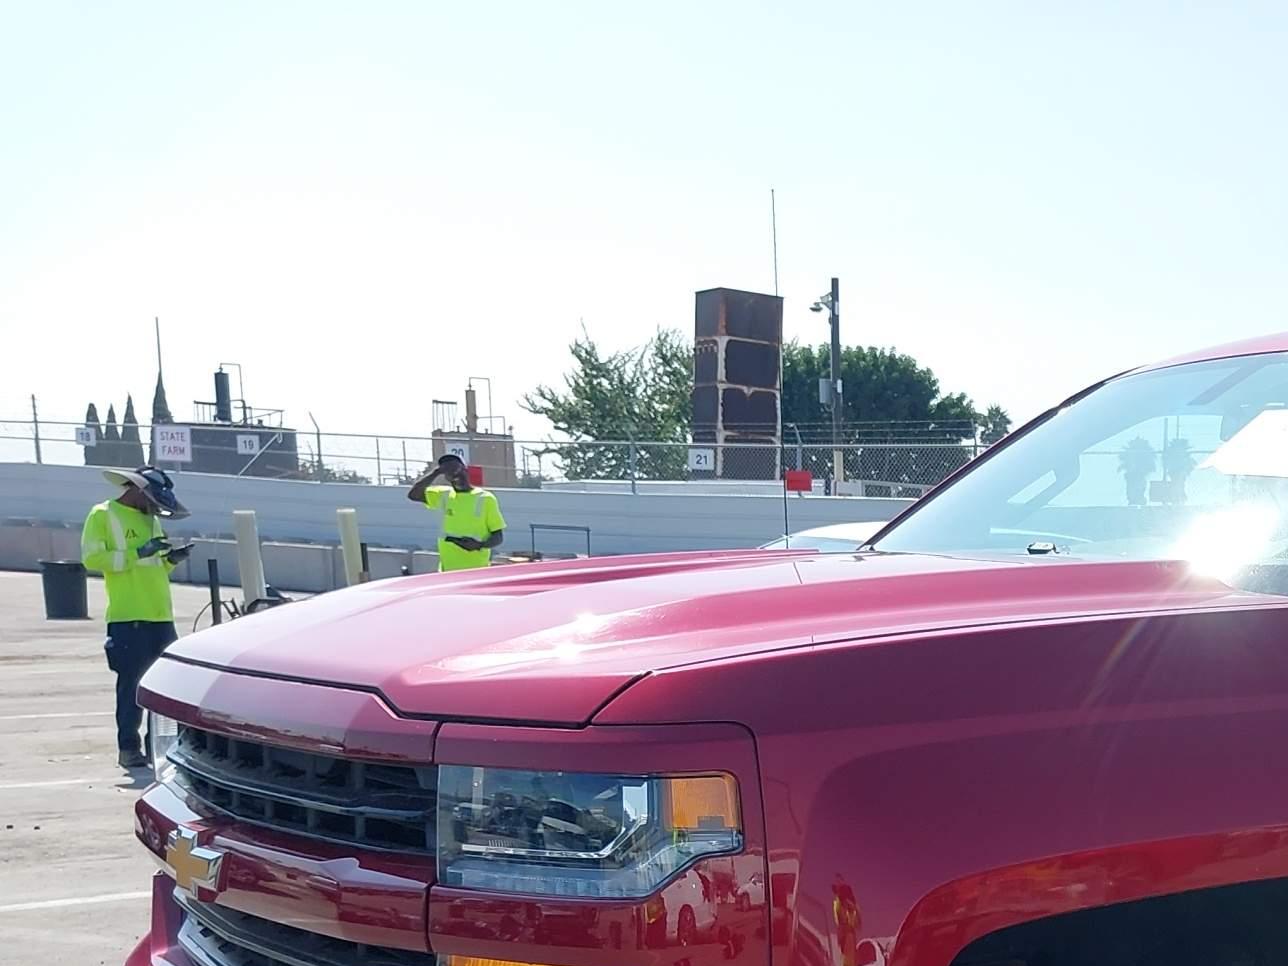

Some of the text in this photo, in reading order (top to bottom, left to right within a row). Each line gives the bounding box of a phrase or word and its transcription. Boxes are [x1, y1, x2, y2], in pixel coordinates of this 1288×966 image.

[80, 431, 91, 442] 18
[160, 431, 187, 442] STATE
[243, 439, 254, 450] 19
[162, 445, 186, 456] FARM
[695, 454, 708, 465] 21
